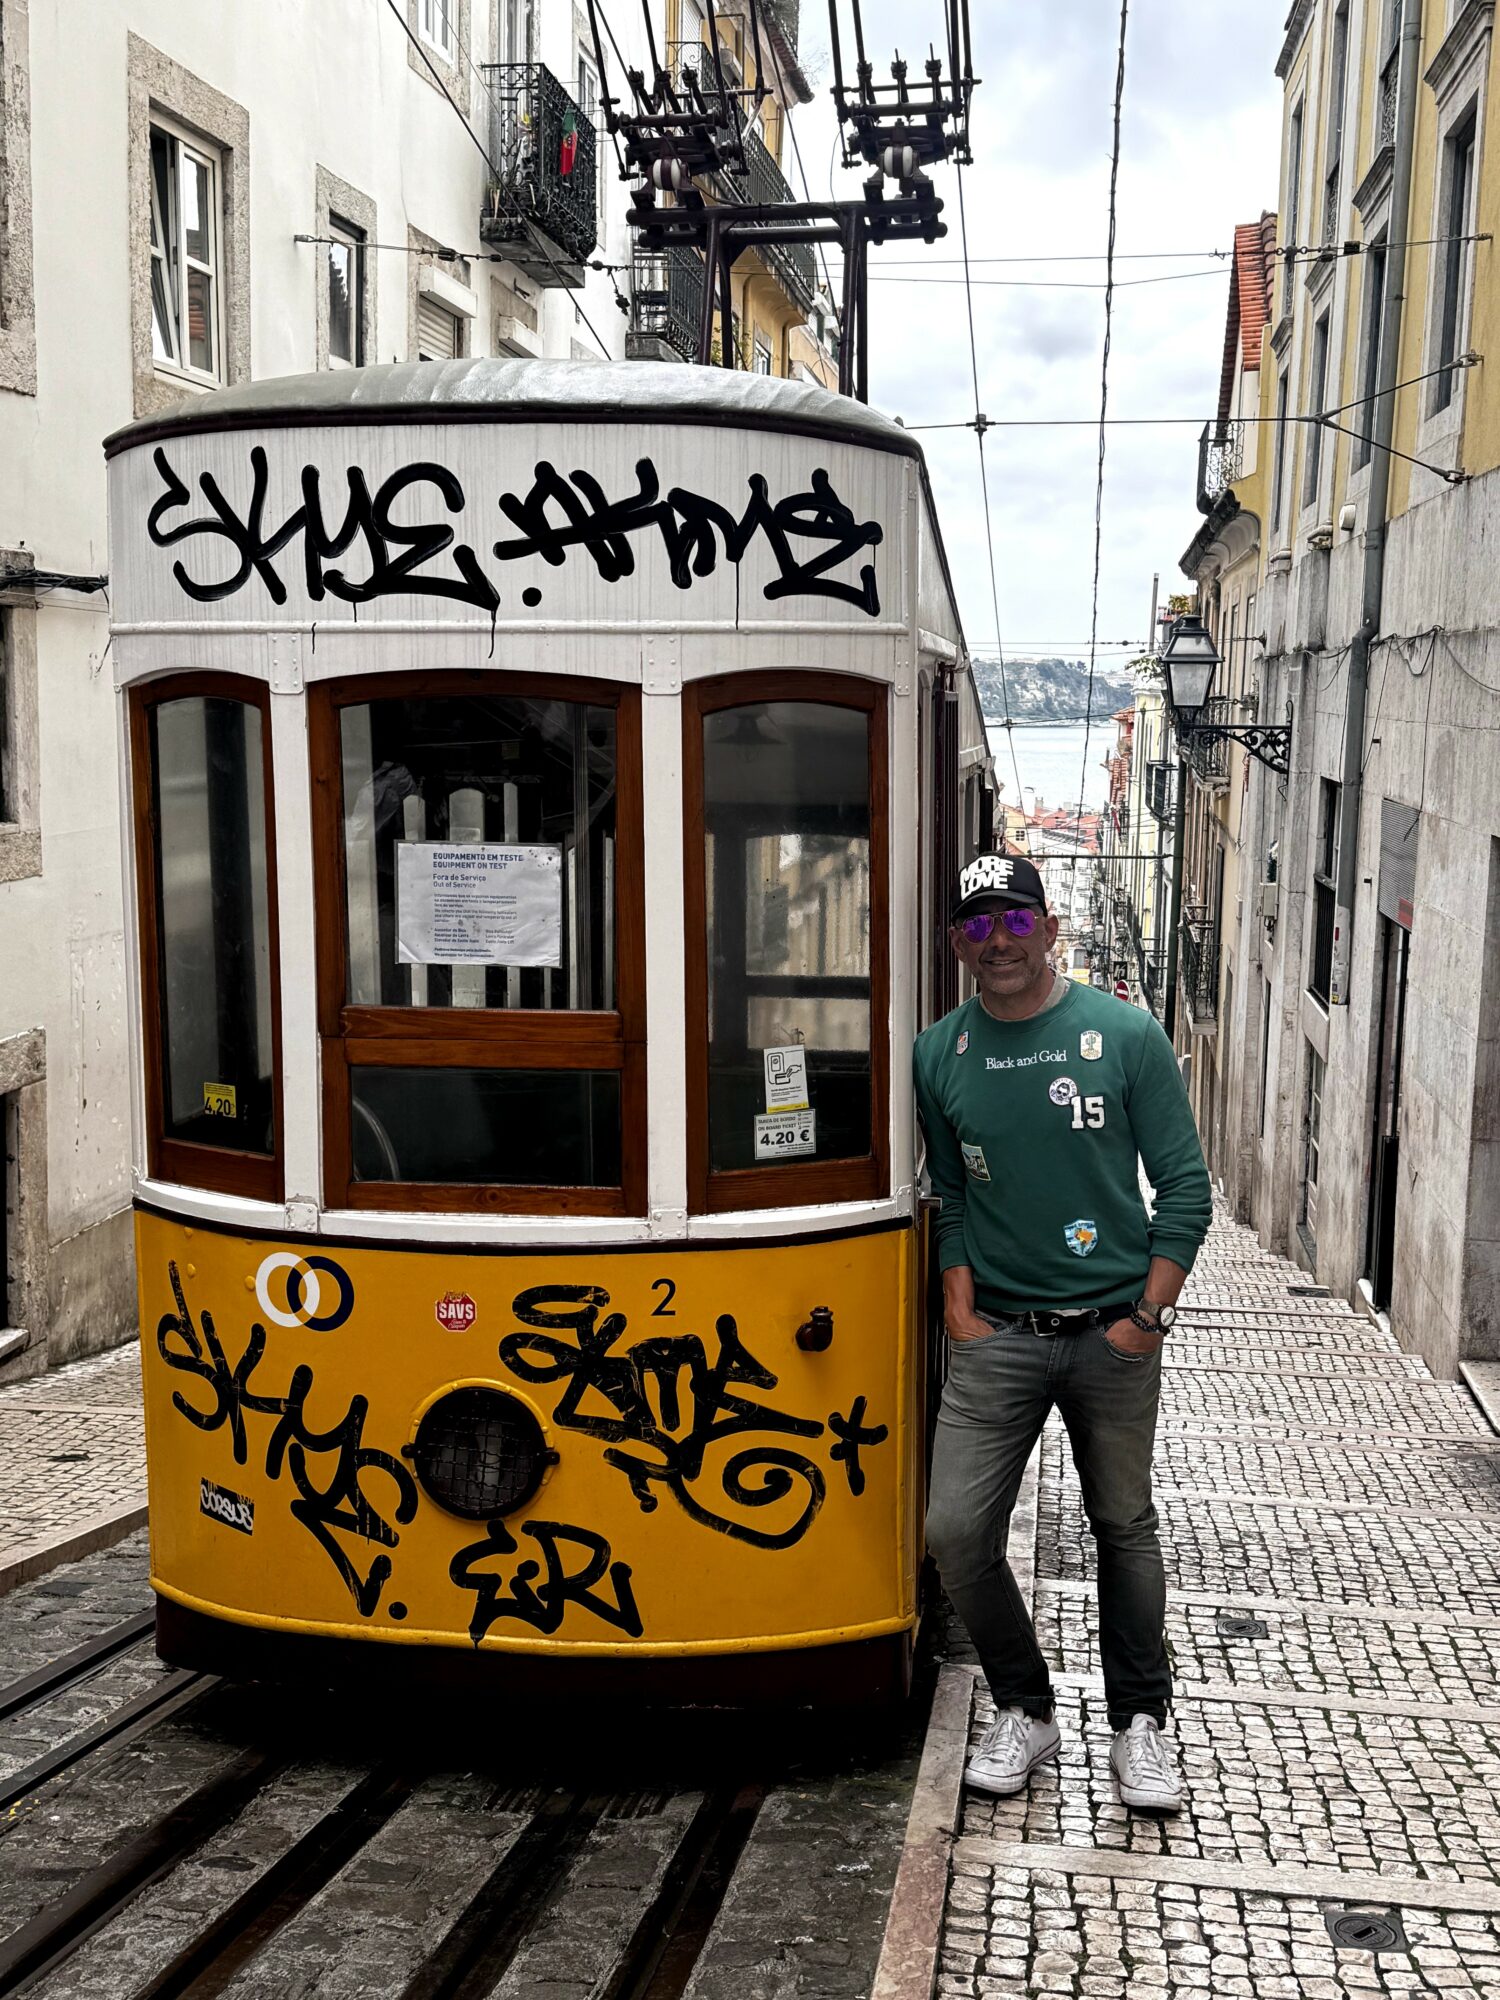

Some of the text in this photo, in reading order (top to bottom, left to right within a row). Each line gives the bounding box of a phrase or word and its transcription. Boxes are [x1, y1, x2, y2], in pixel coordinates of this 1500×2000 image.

[433, 852, 486, 860] EQUIPAMENTO
[499, 854, 525, 862] TESTE
[433, 861, 476, 869] EQUIPMENT
[489, 862, 508, 870] TEST
[433, 873, 487, 882] Fora de Serviço
[959, 855, 1014, 886] MORE
[960, 871, 1009, 901] LOVE
[985, 1049, 1067, 1070] Black and Gold
[1071, 1095, 1106, 1130] 15
[760, 1129, 810, 1146] 4.20 €
[651, 1278, 677, 1316] 2
[438, 1303, 474, 1320] SAVS
